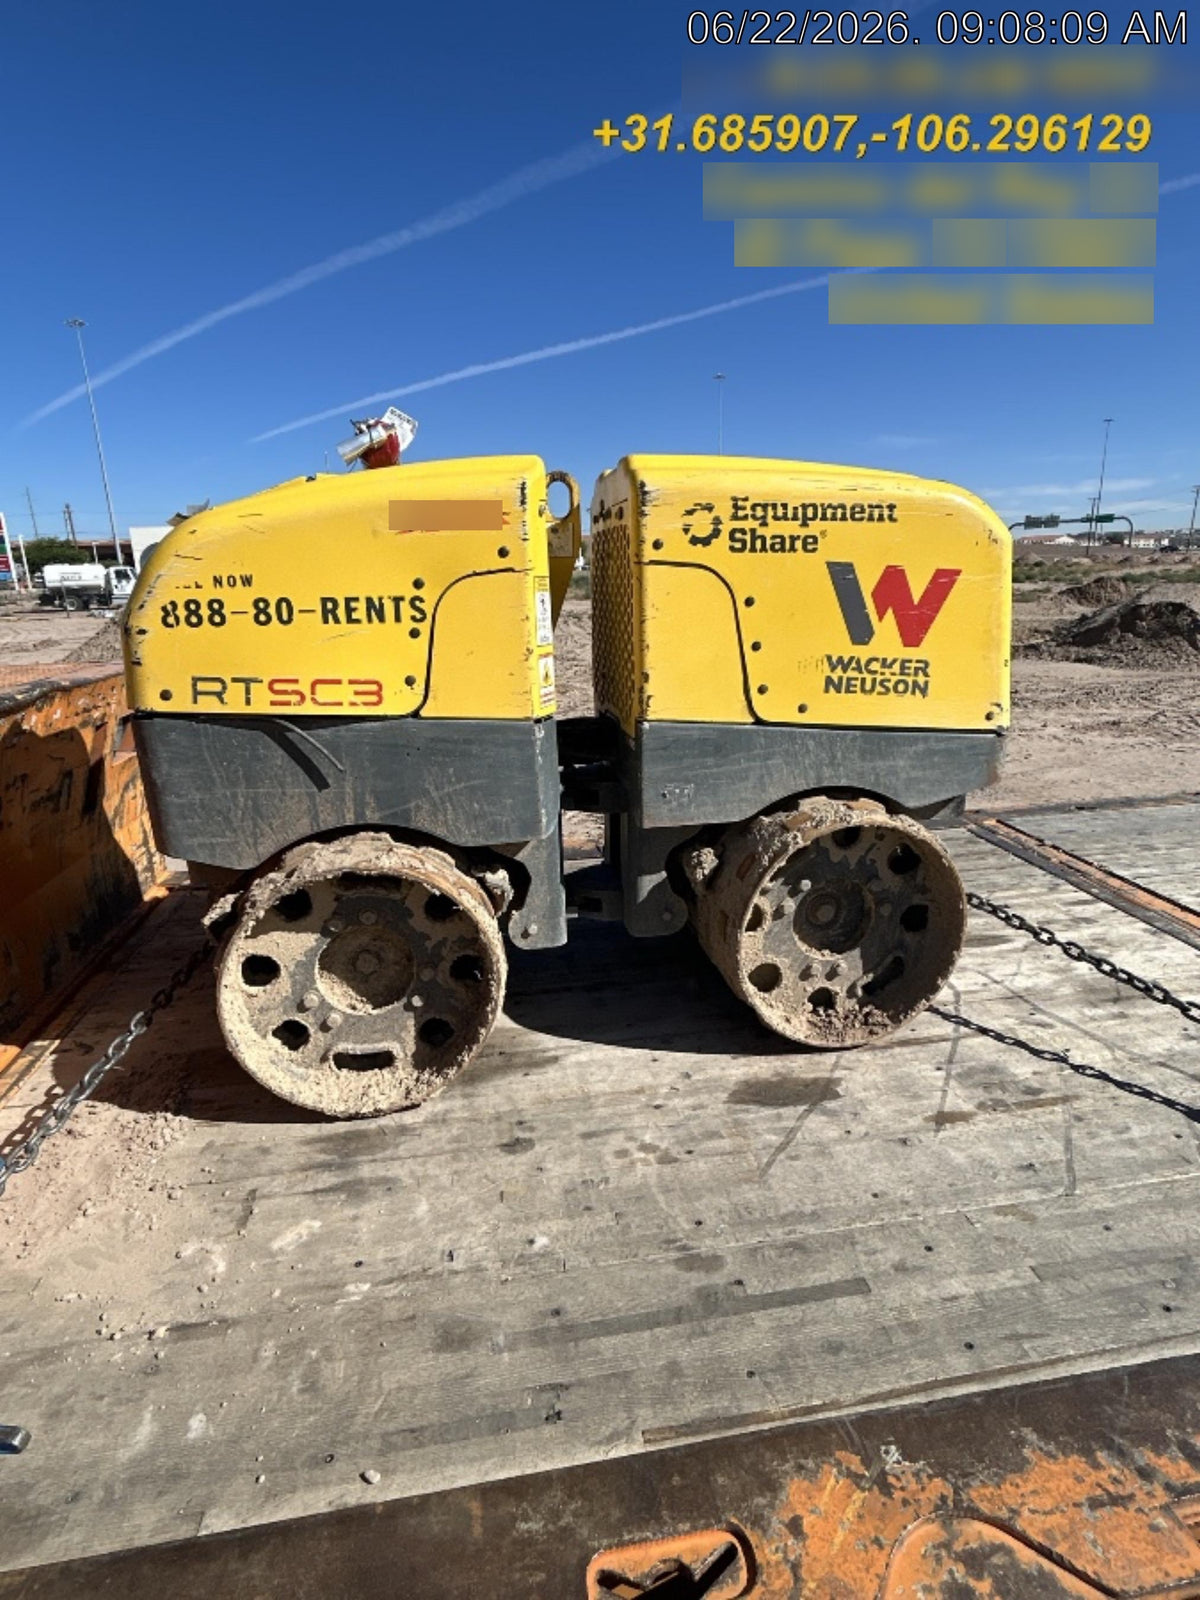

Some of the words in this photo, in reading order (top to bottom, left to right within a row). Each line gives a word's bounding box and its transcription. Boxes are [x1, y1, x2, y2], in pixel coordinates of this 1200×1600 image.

[730, 497, 898, 527] Equipment
[729, 528, 819, 554] Share
[213, 574, 253, 588] NOW
[824, 655, 930, 677] WACKER
[824, 676, 930, 697] NEUSON
